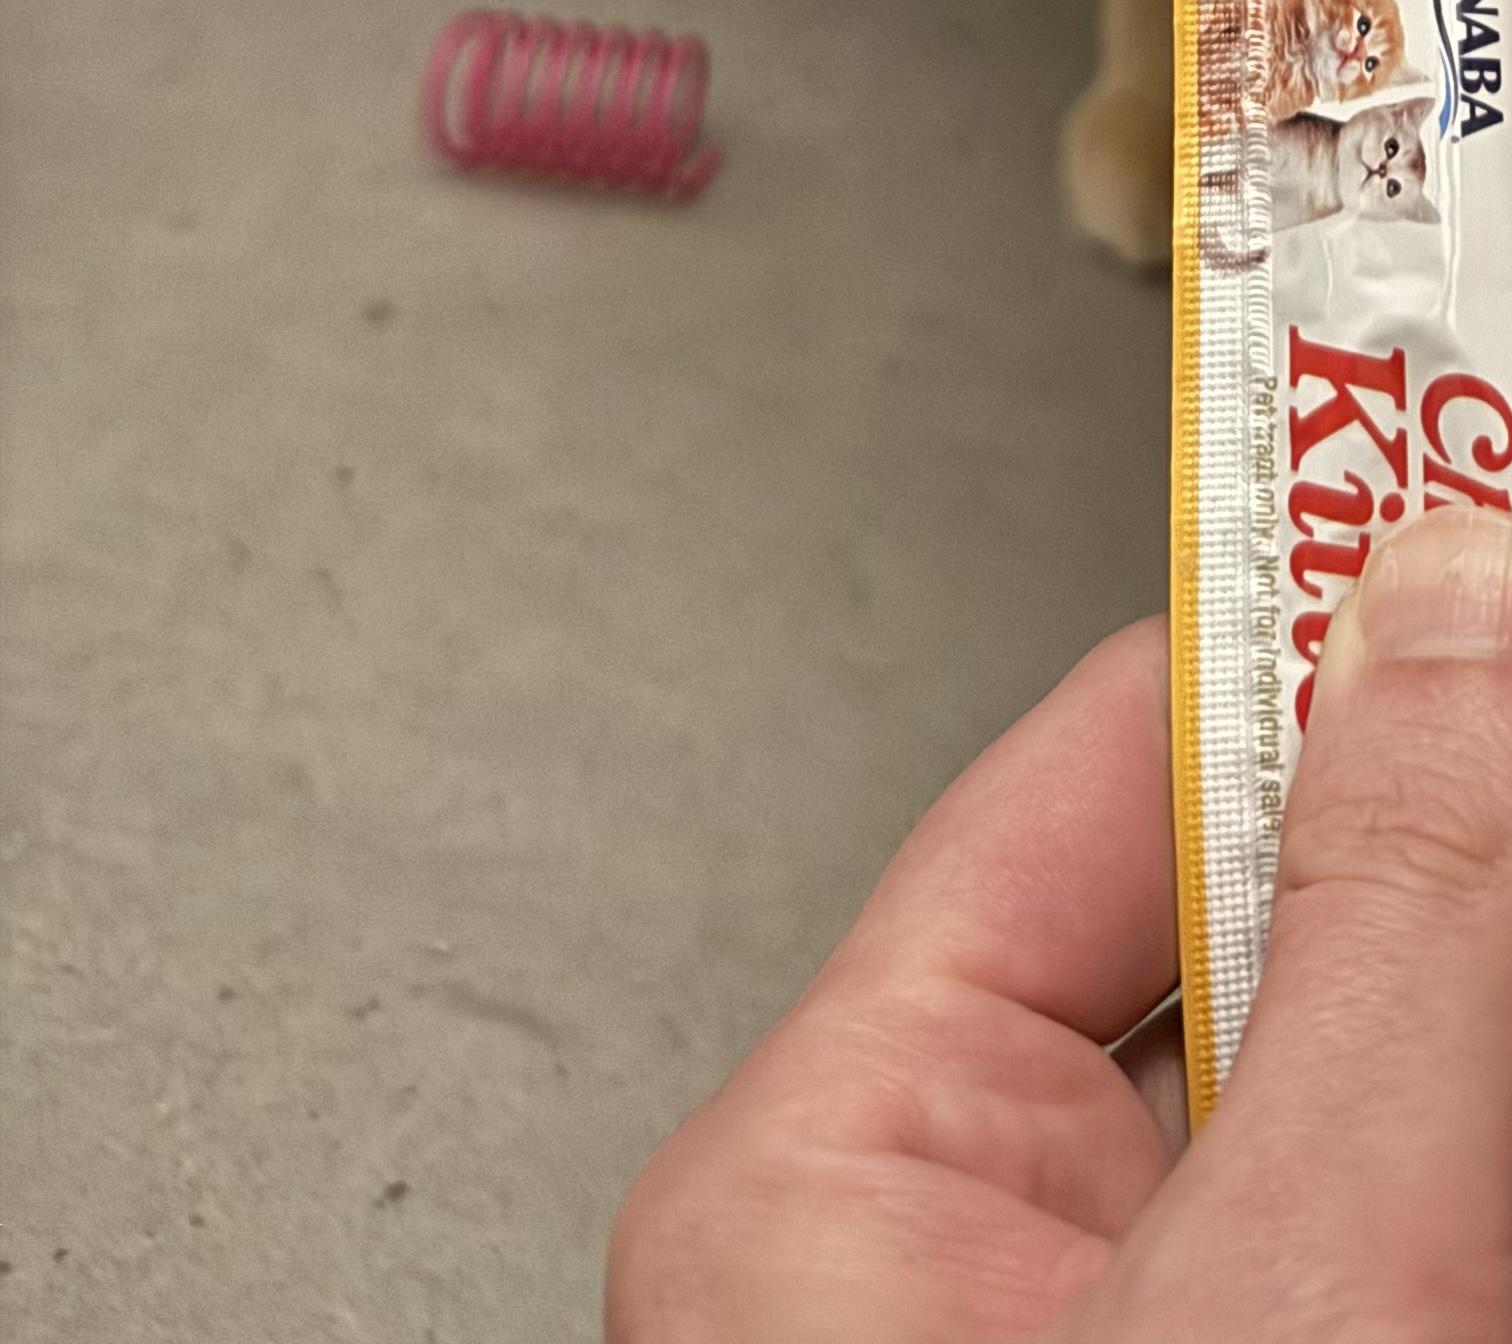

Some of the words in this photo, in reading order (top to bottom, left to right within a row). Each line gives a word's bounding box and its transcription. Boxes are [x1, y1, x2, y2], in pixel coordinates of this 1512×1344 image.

[1288, 325, 1408, 735] Kit
[1254, 555, 1281, 599] Not
[1256, 604, 1281, 642] for
[1255, 647, 1285, 772] individual
